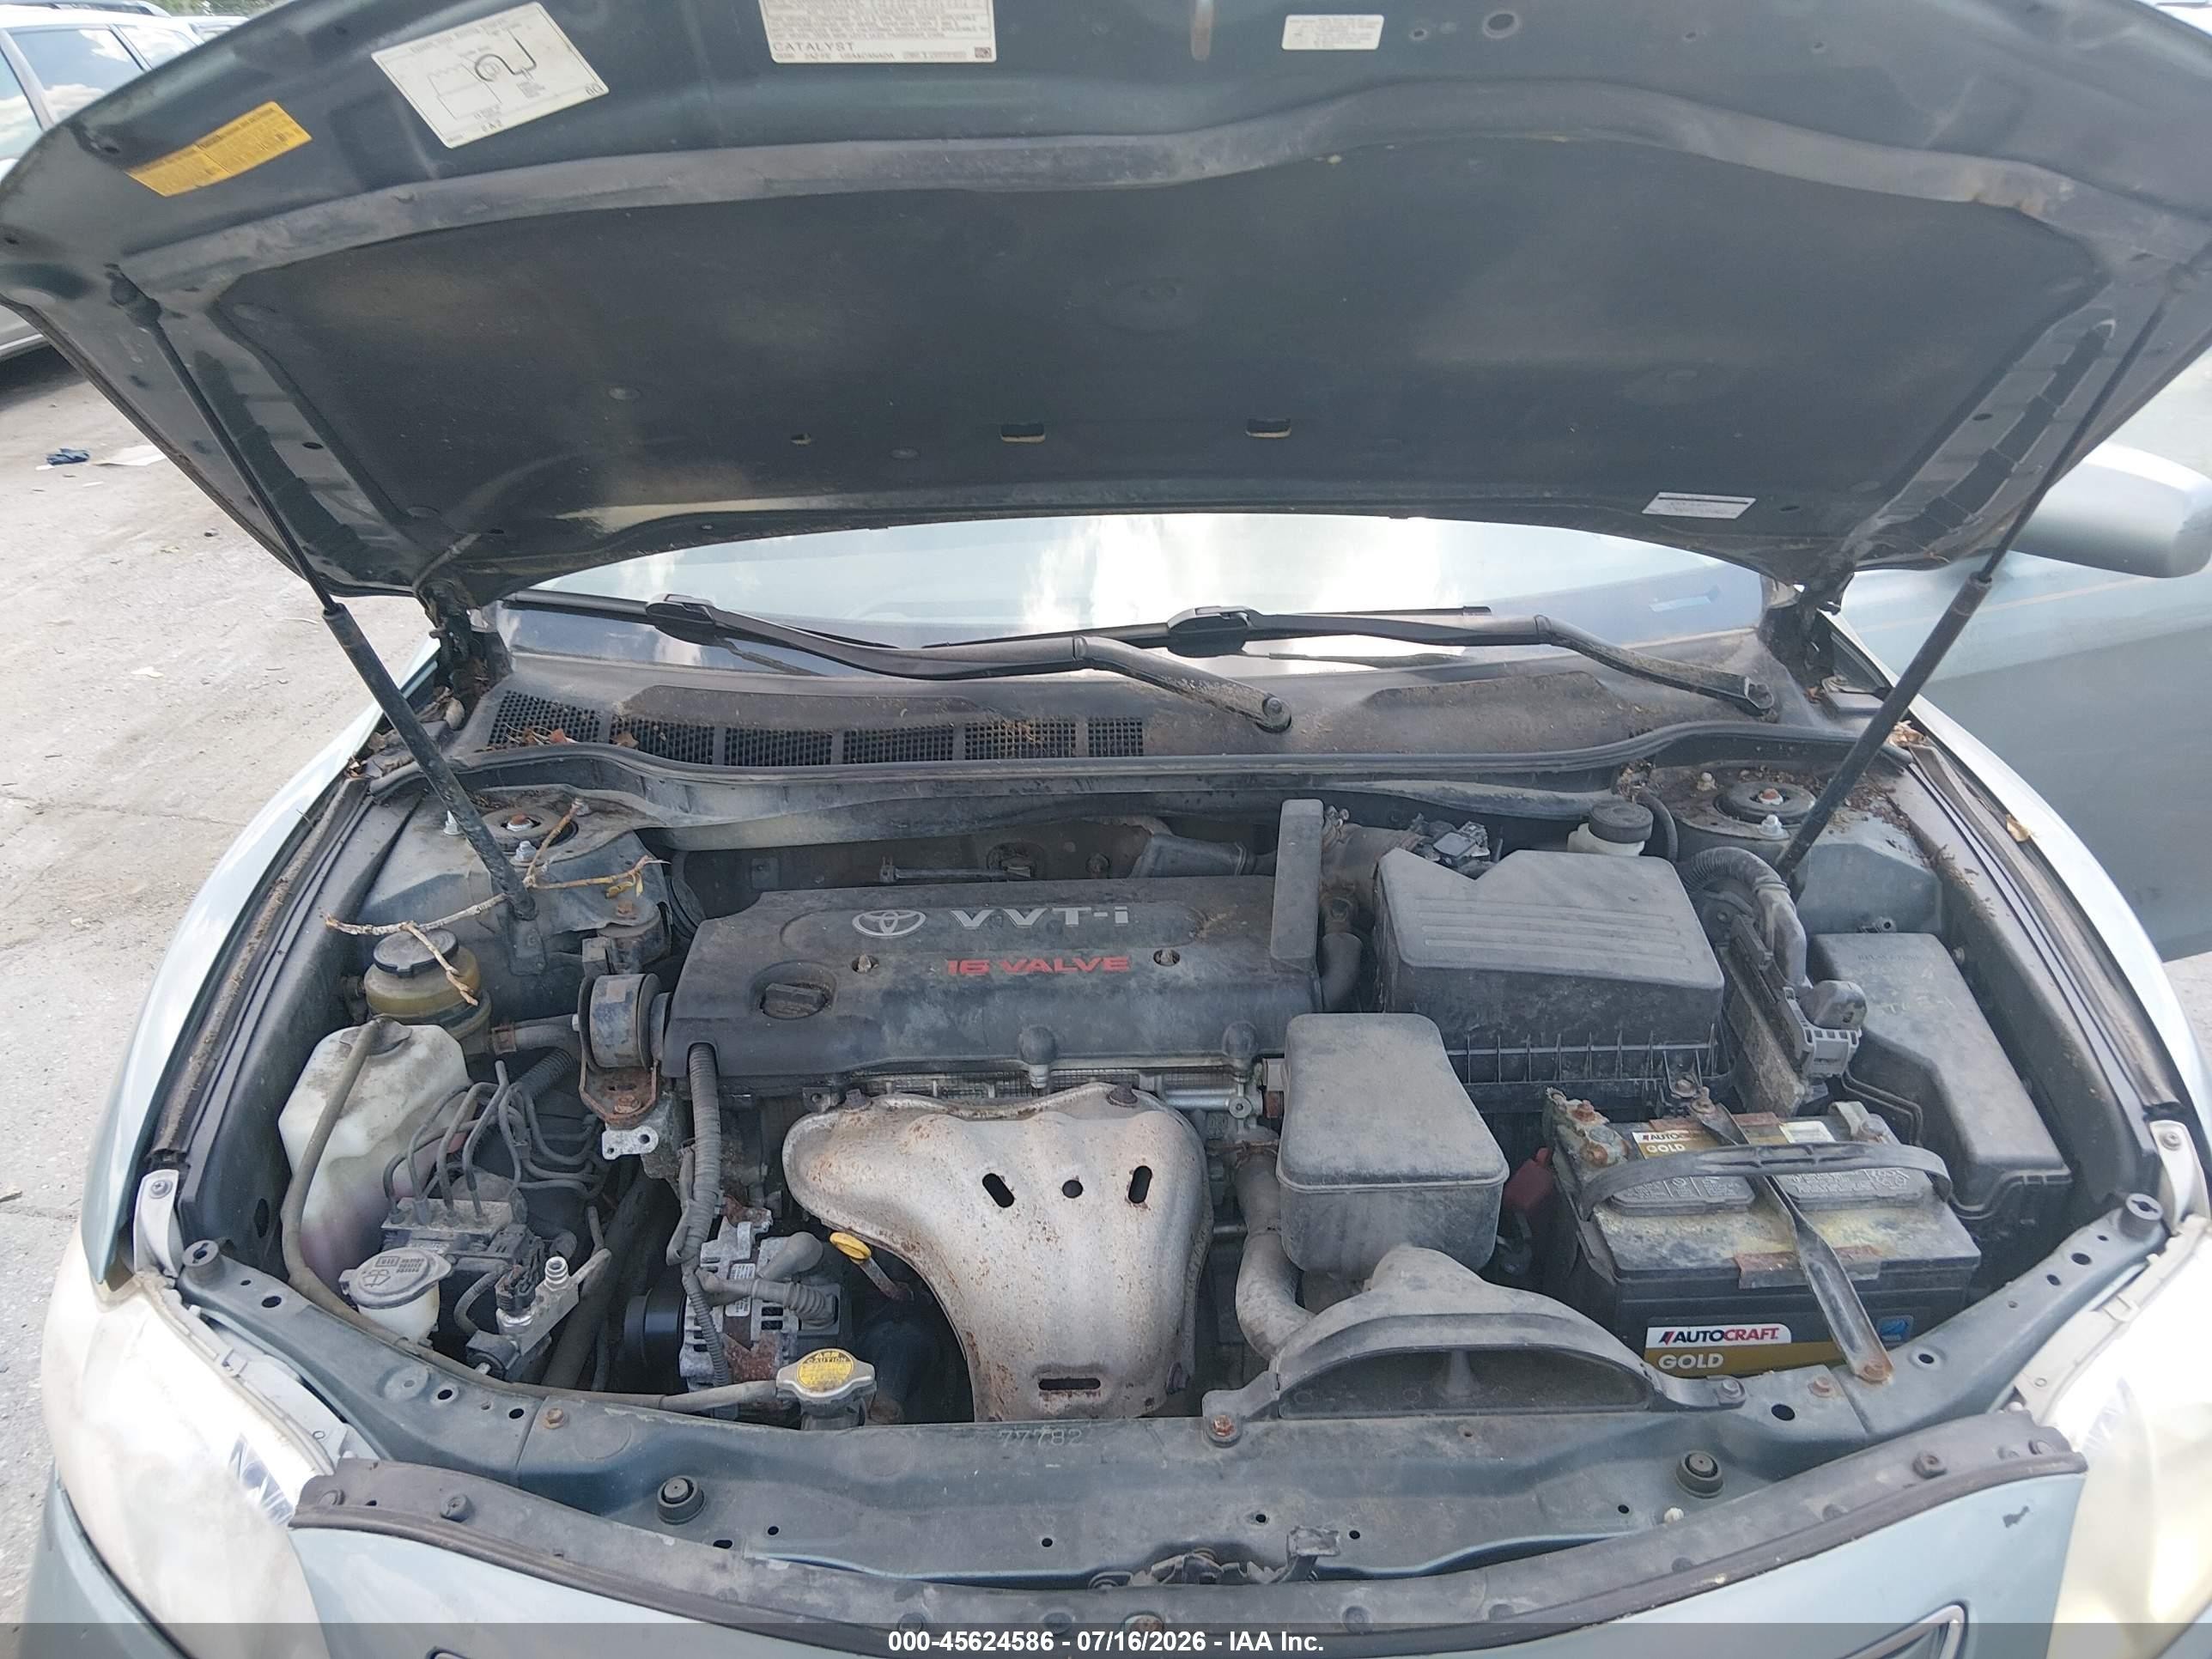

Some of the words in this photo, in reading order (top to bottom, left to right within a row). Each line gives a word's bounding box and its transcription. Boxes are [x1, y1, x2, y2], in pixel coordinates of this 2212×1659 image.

[773, 41, 854, 52] CATALYST
[950, 906, 1128, 927] VVT-i
[947, 959, 989, 975] 16
[1000, 956, 1131, 974] VALVE
[1646, 1143, 1686, 1153] GOLD
[1673, 1328, 1780, 1343] AUTOCRAFT
[1658, 1353, 1724, 1370] GOLD
[999, 1428, 1082, 1446] 77782
